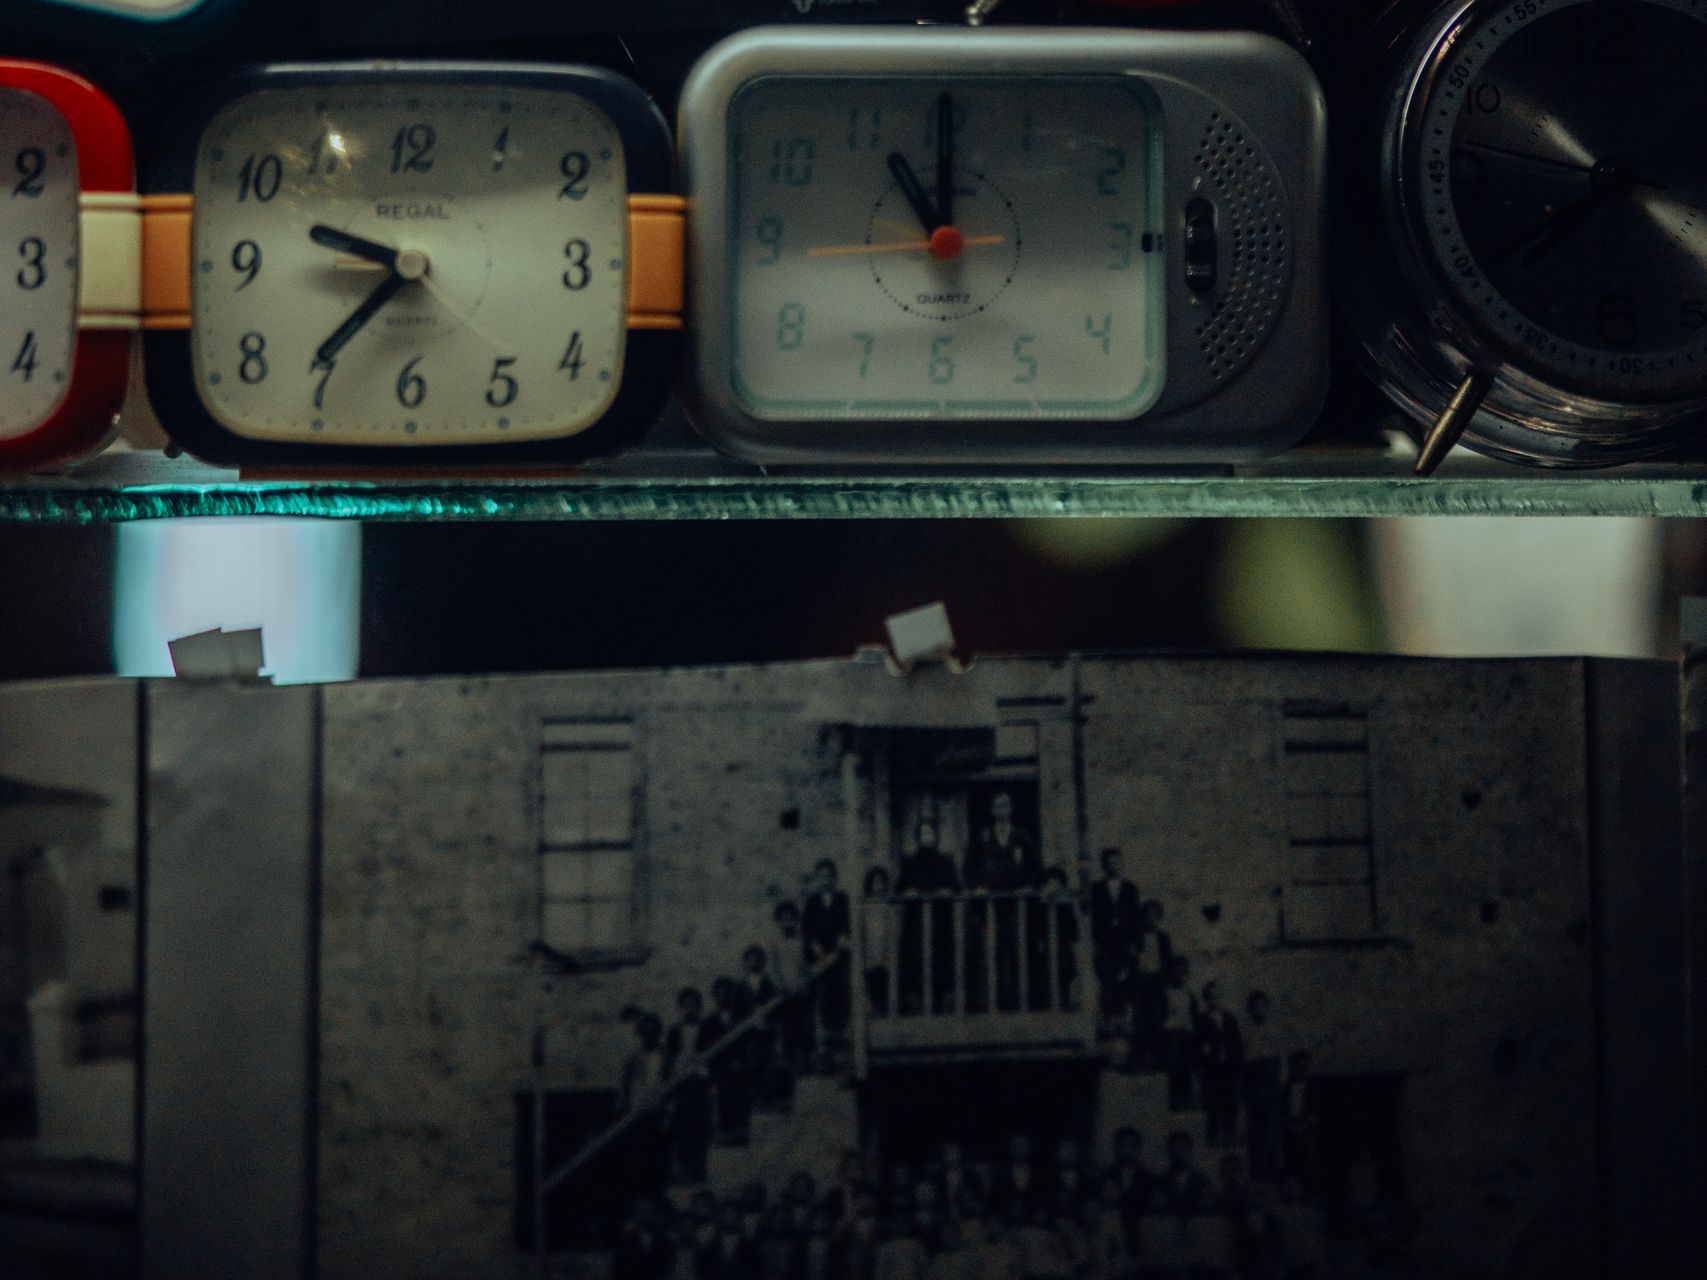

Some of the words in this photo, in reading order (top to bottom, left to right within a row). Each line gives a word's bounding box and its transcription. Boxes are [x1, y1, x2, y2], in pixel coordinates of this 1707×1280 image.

[1450, 64, 1470, 89] 50
[1466, 83, 1500, 114] 10
[12, 146, 46, 199] 2
[390, 124, 437, 175] 12
[771, 136, 815, 186] 10
[1097, 148, 1127, 196] 2
[1429, 159, 1444, 182] 45
[237, 152, 284, 203] 10
[557, 150, 591, 201] 2
[17, 237, 47, 290] 3
[232, 239, 263, 293] 9
[563, 238, 592, 291] 3
[756, 217, 783, 267] 9
[1107, 222, 1132, 271] 3
[916, 293, 971, 306] QUARTZ
[776, 303, 805, 352] 8
[1085, 314, 1112, 354] 4
[12, 329, 40, 383] 4
[238, 331, 268, 385] 8
[557, 330, 586, 382] 4
[852, 333, 875, 378] 7
[929, 335, 955, 386] 6
[1012, 335, 1039, 385] 5
[396, 354, 427, 409] 6
[485, 357, 519, 408] 5
